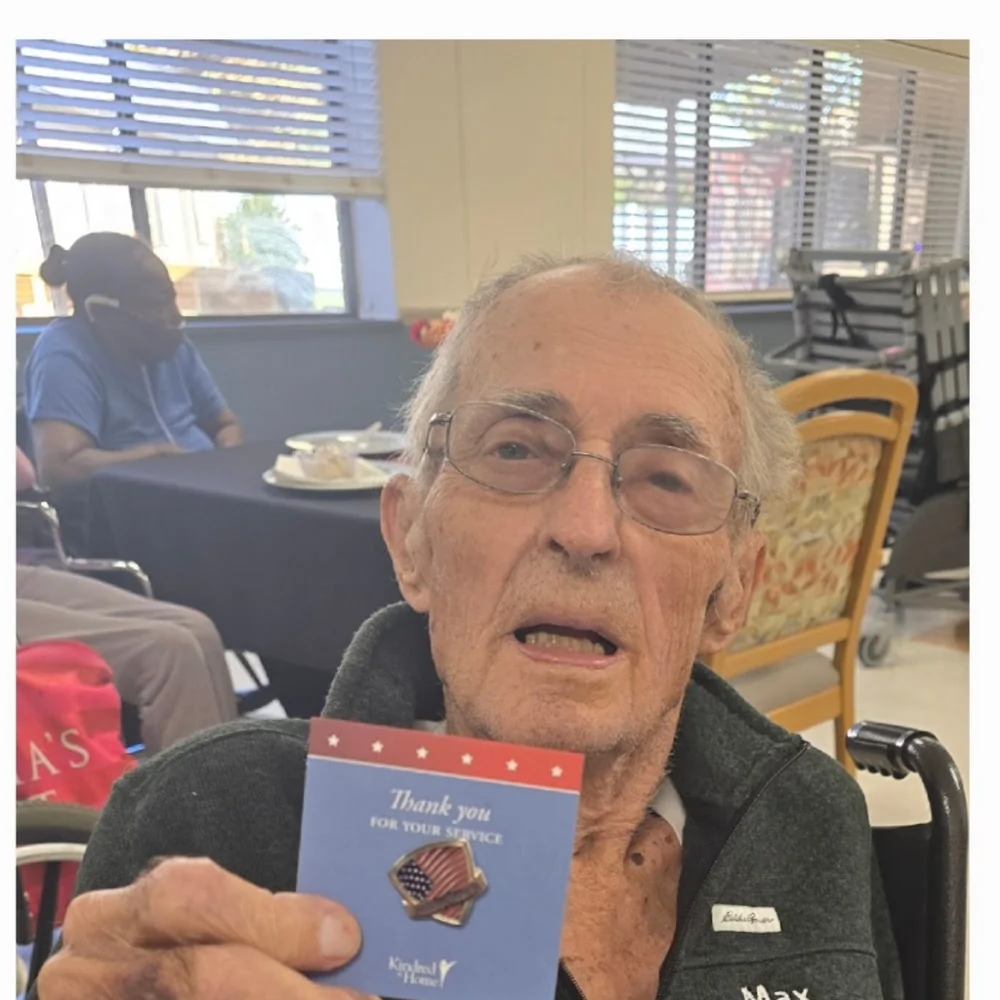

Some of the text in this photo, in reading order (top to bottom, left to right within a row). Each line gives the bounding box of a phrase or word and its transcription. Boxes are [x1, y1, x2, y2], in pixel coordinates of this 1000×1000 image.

[16, 728, 90, 786] A'S
[389, 788, 492, 824] Thank you
[370, 815, 503, 846] FOR YOUR SERVICE
[388, 956, 437, 976] Kindred
[403, 972, 440, 989] Home
